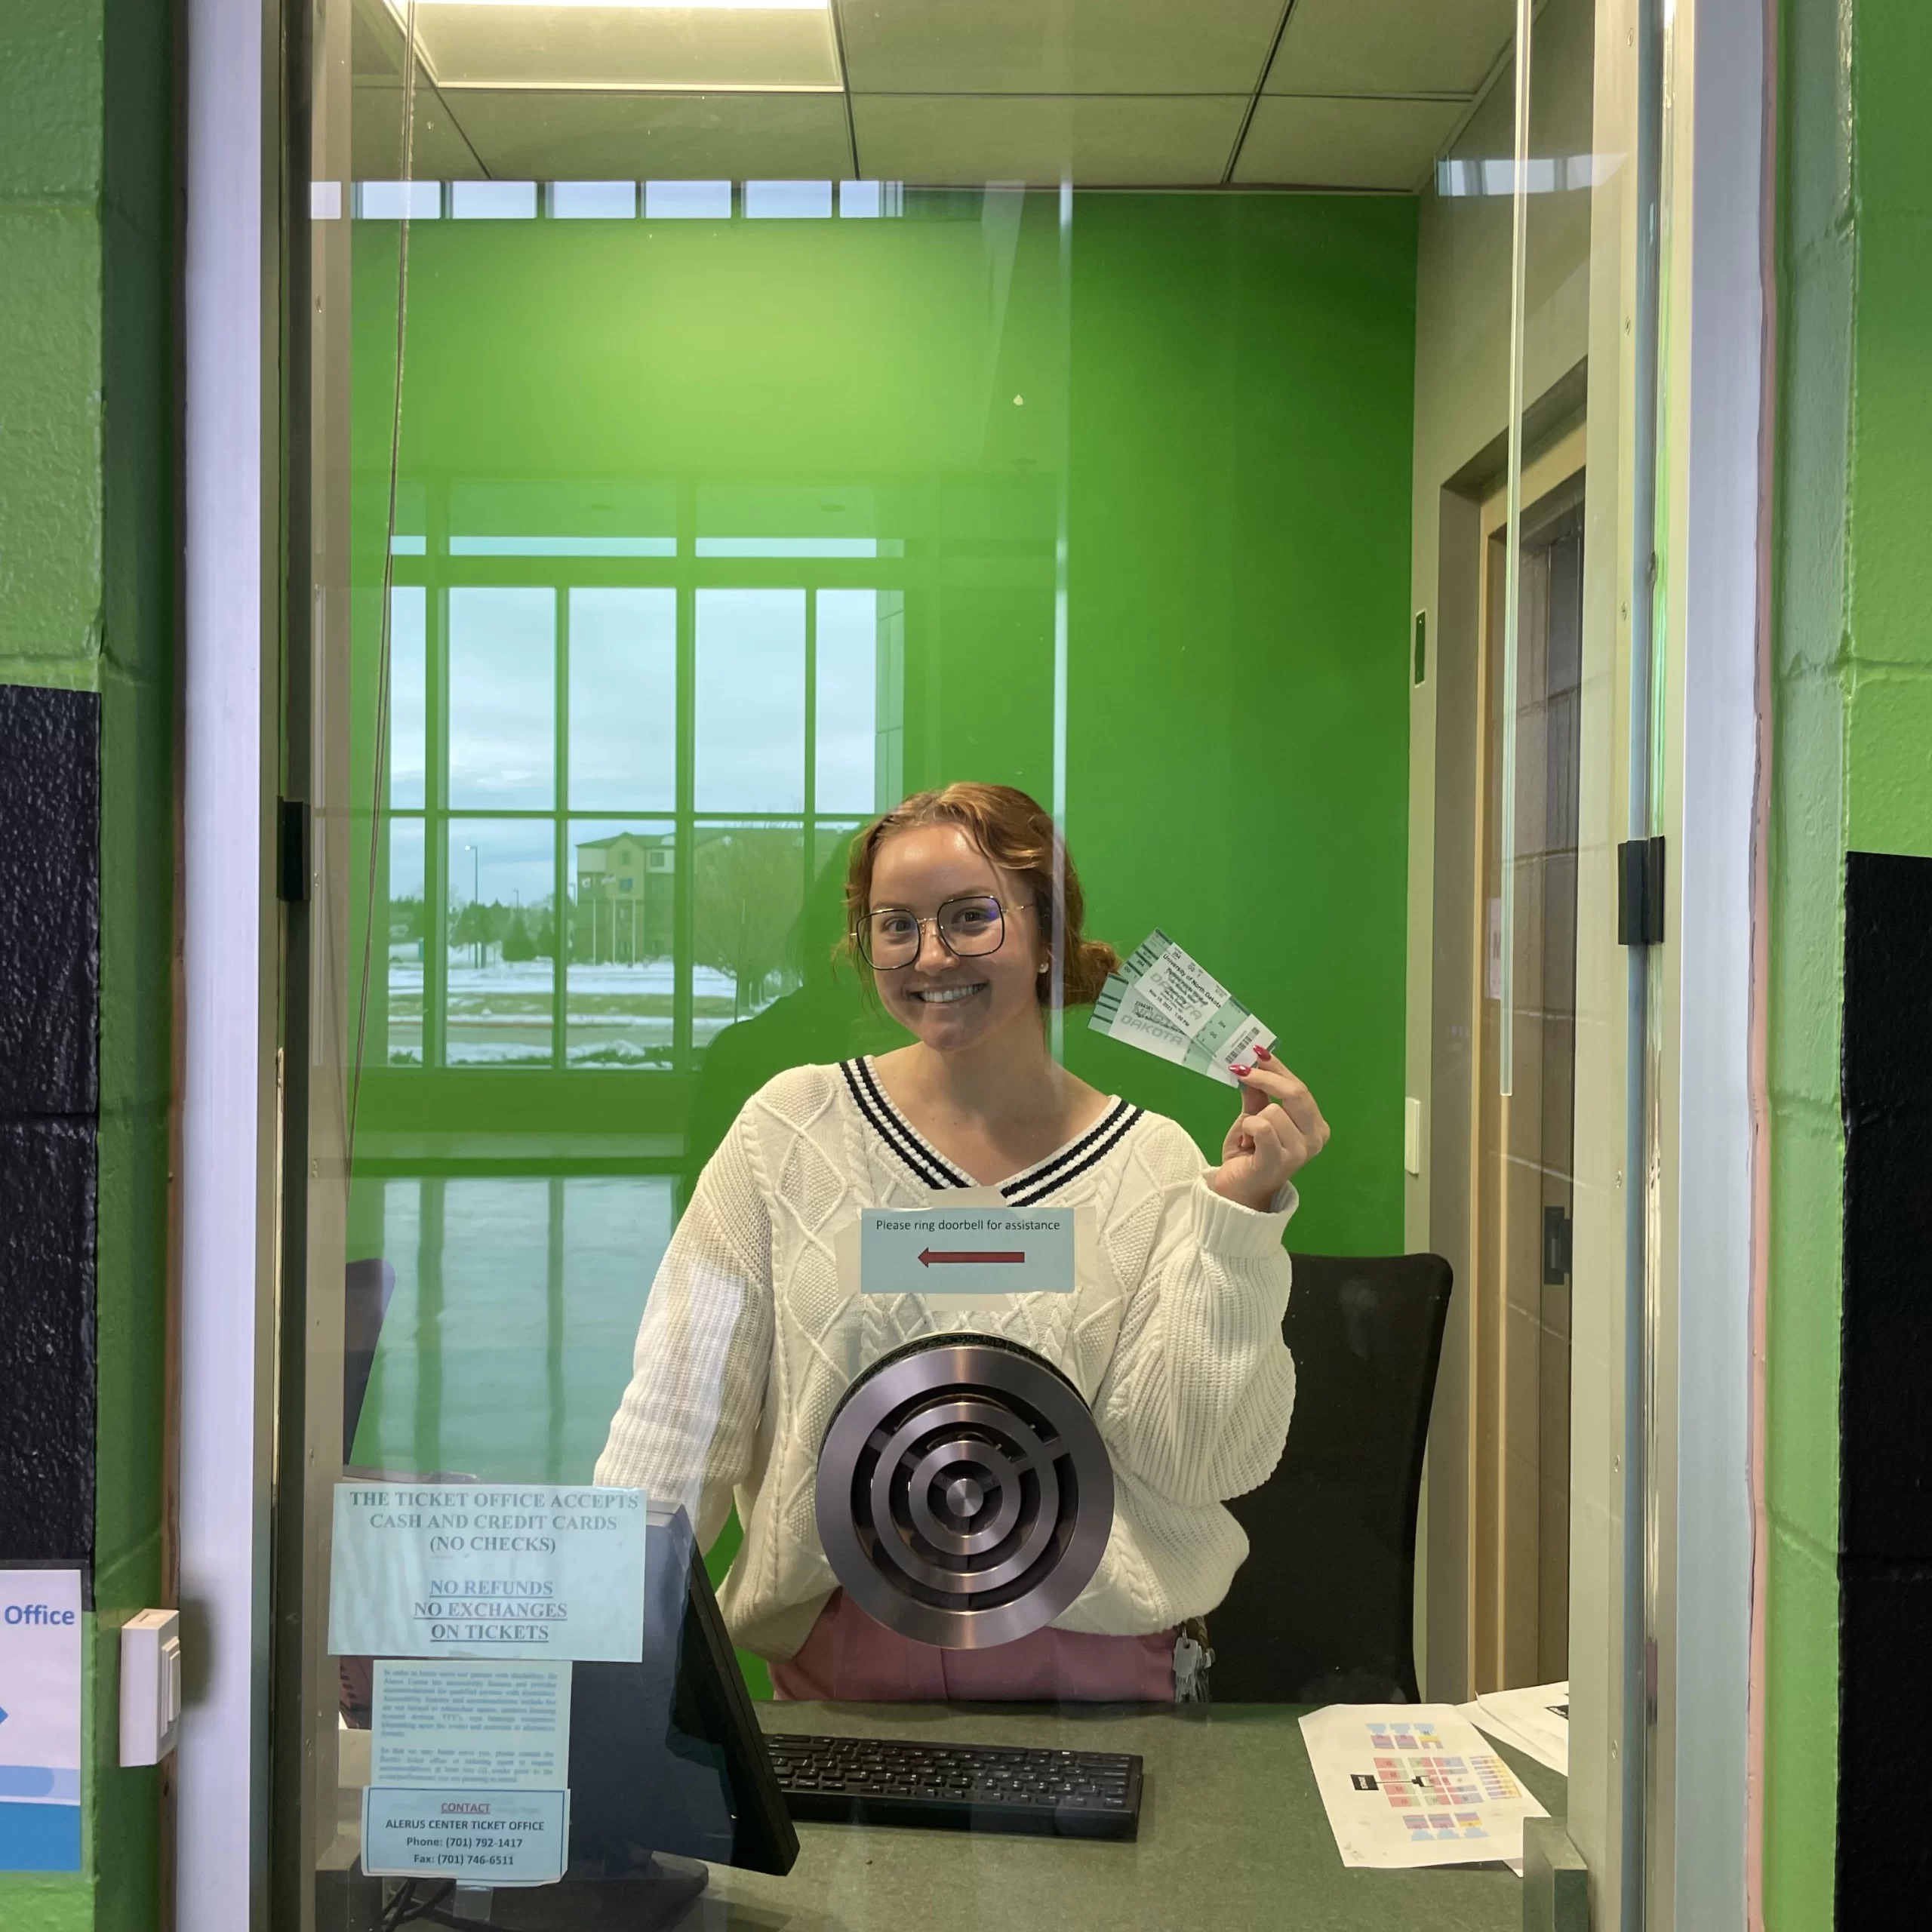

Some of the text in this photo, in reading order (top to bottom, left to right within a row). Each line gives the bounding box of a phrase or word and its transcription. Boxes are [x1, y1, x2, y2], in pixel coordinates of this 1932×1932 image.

[1161, 953, 1187, 977] University
[1191, 980, 1205, 993] North
[1204, 991, 1222, 1008] Dakota
[1119, 1013, 1183, 1047] DAKOTA
[876, 1220, 1060, 1232] Please ring doorbell for assistance
[350, 1491, 638, 1509] THE TICKET OFFICE ACCEPTS
[370, 1513, 617, 1531] CASH AND CREDIT CARDS
[430, 1536, 555, 1553] (NO CHECKS)
[430, 1580, 552, 1595] NO REFUNDS
[5, 1604, 75, 1626] Office
[414, 1602, 567, 1618] NO EXCHANGES
[431, 1624, 549, 1640] ON TICKETS
[441, 1803, 491, 1814] CONTACT
[386, 1820, 544, 1830] ALERUS CENTER TICKET OFFICE
[407, 1837, 522, 1848] Phone: (701) 792-1417
[414, 1854, 513, 1866] Fax: (701) 746-6511
